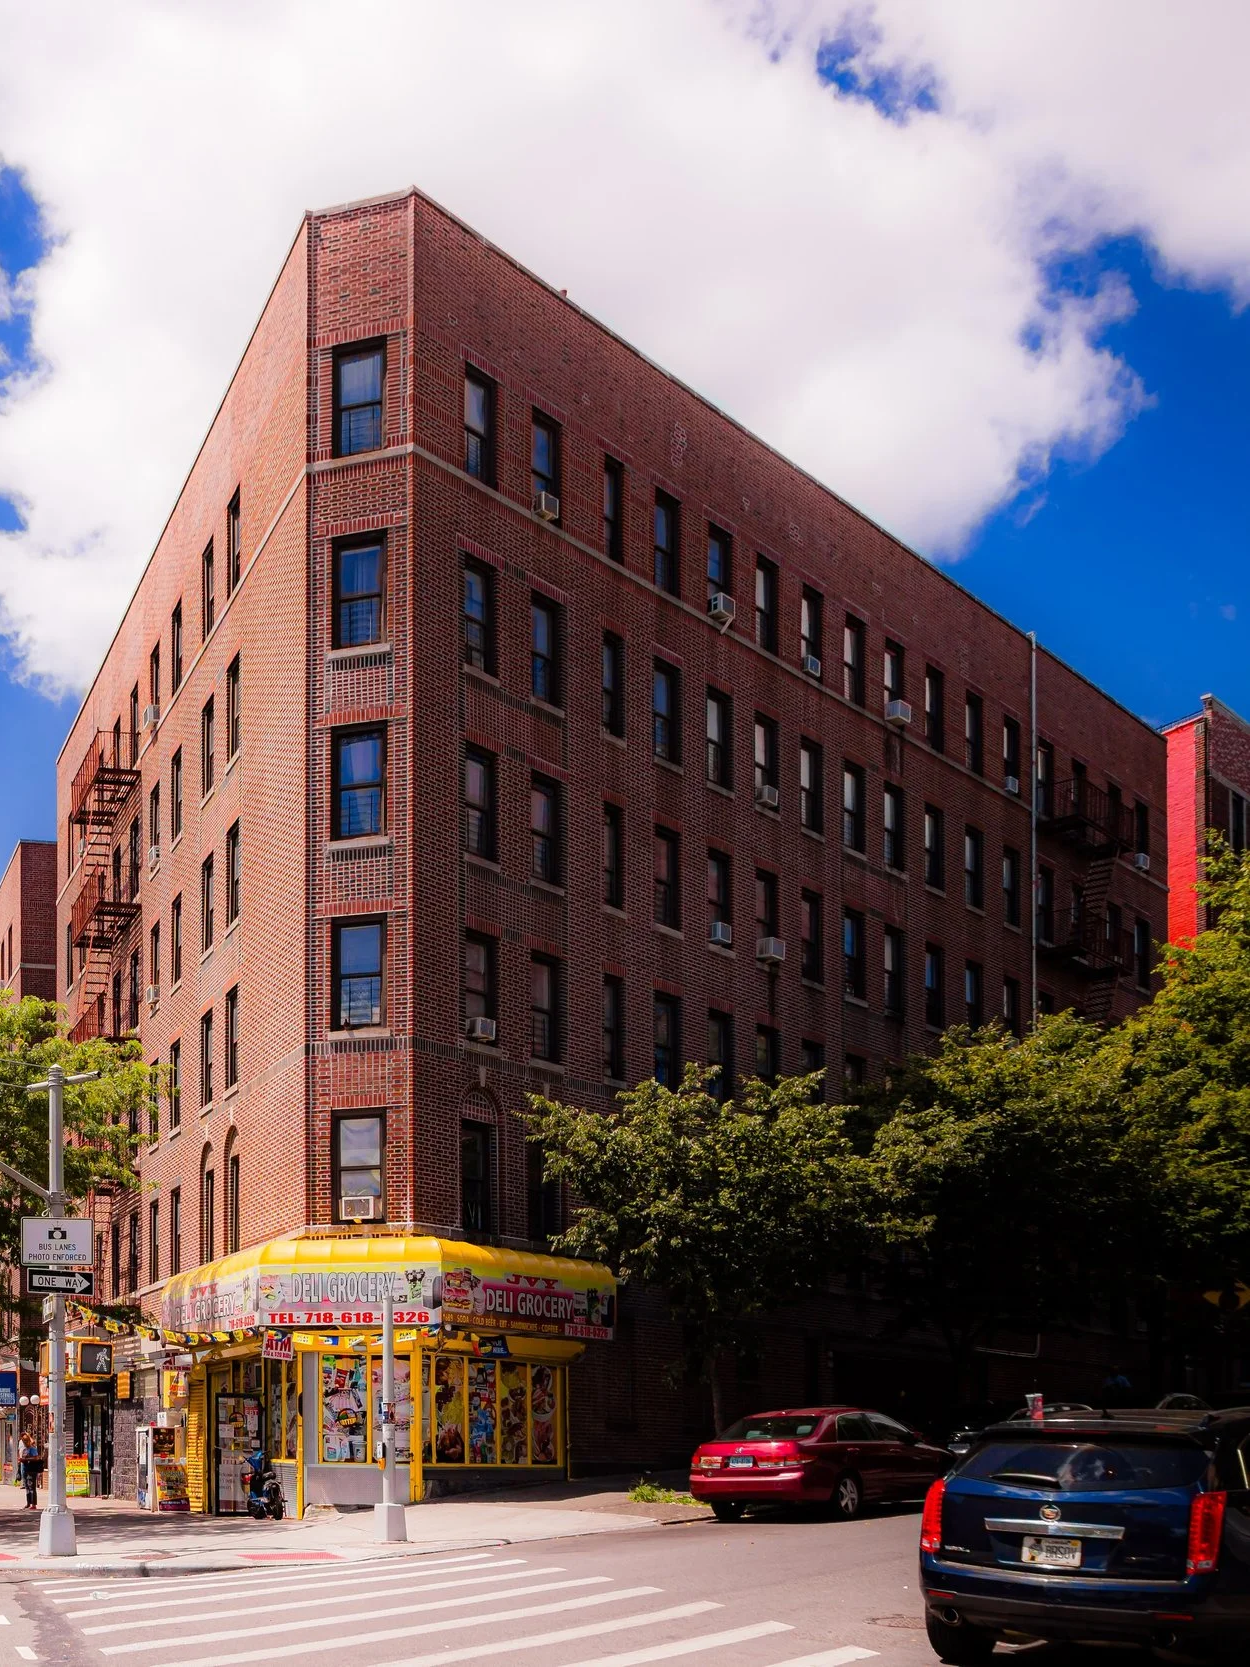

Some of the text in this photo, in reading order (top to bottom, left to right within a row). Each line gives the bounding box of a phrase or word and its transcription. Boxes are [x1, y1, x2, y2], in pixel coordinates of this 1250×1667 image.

[38, 1243, 52, 1251] BUS
[28, 1253, 50, 1261] PHOTO
[37, 1276, 84, 1288] ONE WAY
[292, 1272, 396, 1303] DELI GROCERY
[506, 1273, 558, 1289] JVY
[175, 1303, 192, 1327] DELI
[195, 1292, 236, 1322] GROCERY
[486, 1288, 573, 1320] DELI GROCERY
[268, 1311, 430, 1324] TEL: 718-618-326
[456, 1314, 470, 1324] SODA
[472, 1316, 485, 1326] COLD
[485, 1318, 497, 1327] BEER
[265, 1335, 291, 1353] ATM
